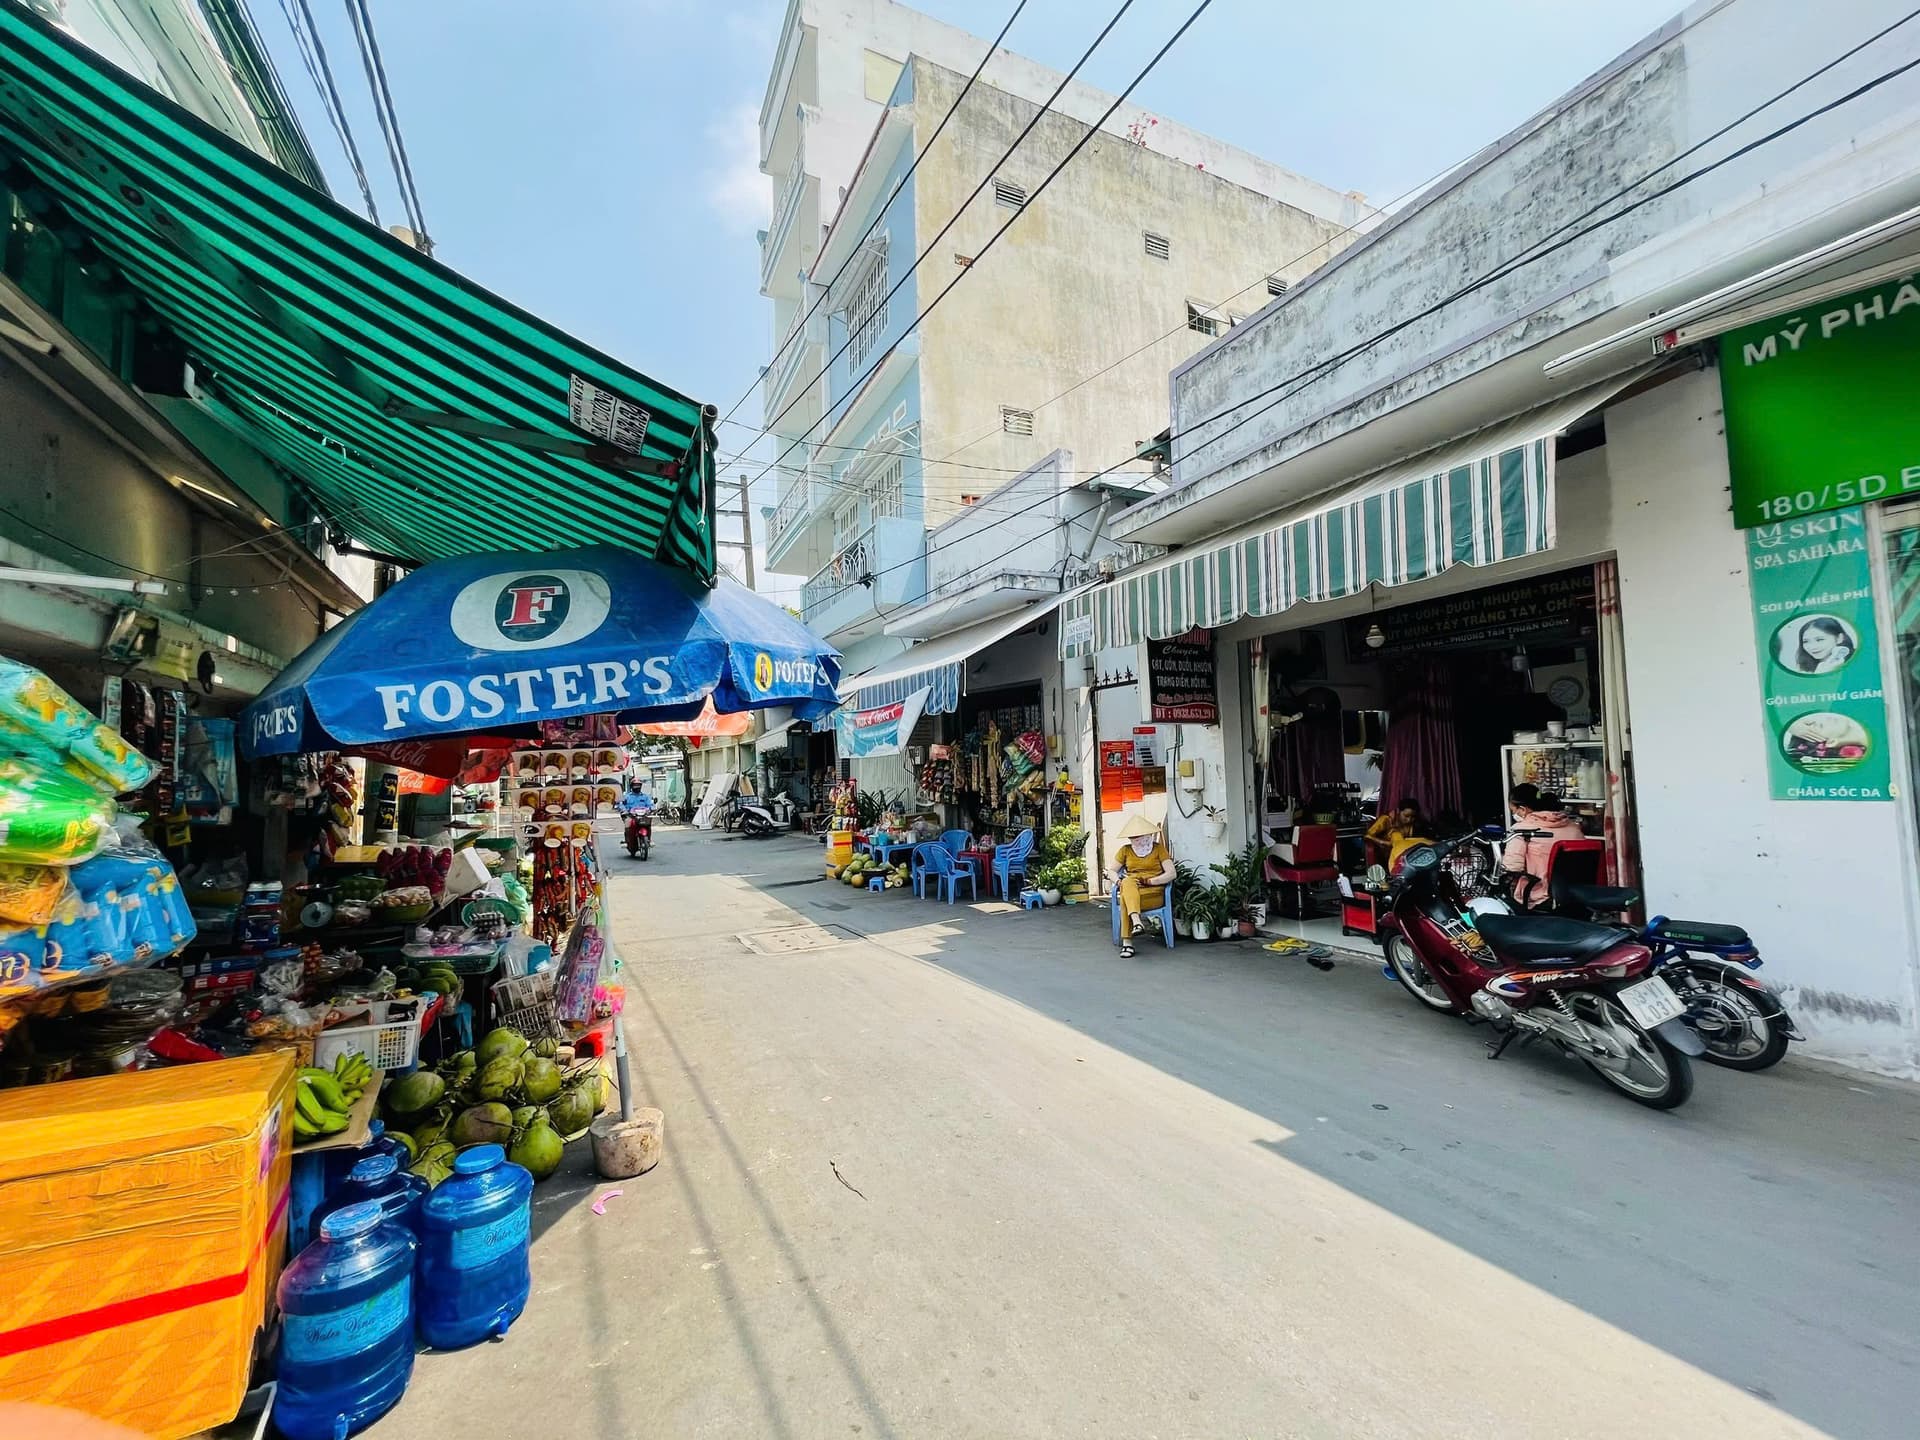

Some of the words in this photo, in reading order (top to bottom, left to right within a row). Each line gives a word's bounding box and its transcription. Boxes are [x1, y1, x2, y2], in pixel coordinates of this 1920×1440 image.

[1743, 316, 1808, 366] MỸ
[1757, 474, 1887, 519] 180/5D
[1790, 511, 1861, 540] SKIN
[1754, 553, 1785, 570] SPA
[1788, 537, 1865, 564] SAHARA
[503, 586, 564, 627] F
[1760, 603, 1782, 613] SOI
[1785, 599, 1804, 610] DA
[1843, 585, 1870, 601] PHÍ
[375, 655, 674, 731] FOSTER'S
[1819, 690, 1848, 702] THƯ
[1787, 785, 1826, 798] CHĂM
[1829, 785, 1857, 798] SÓC
